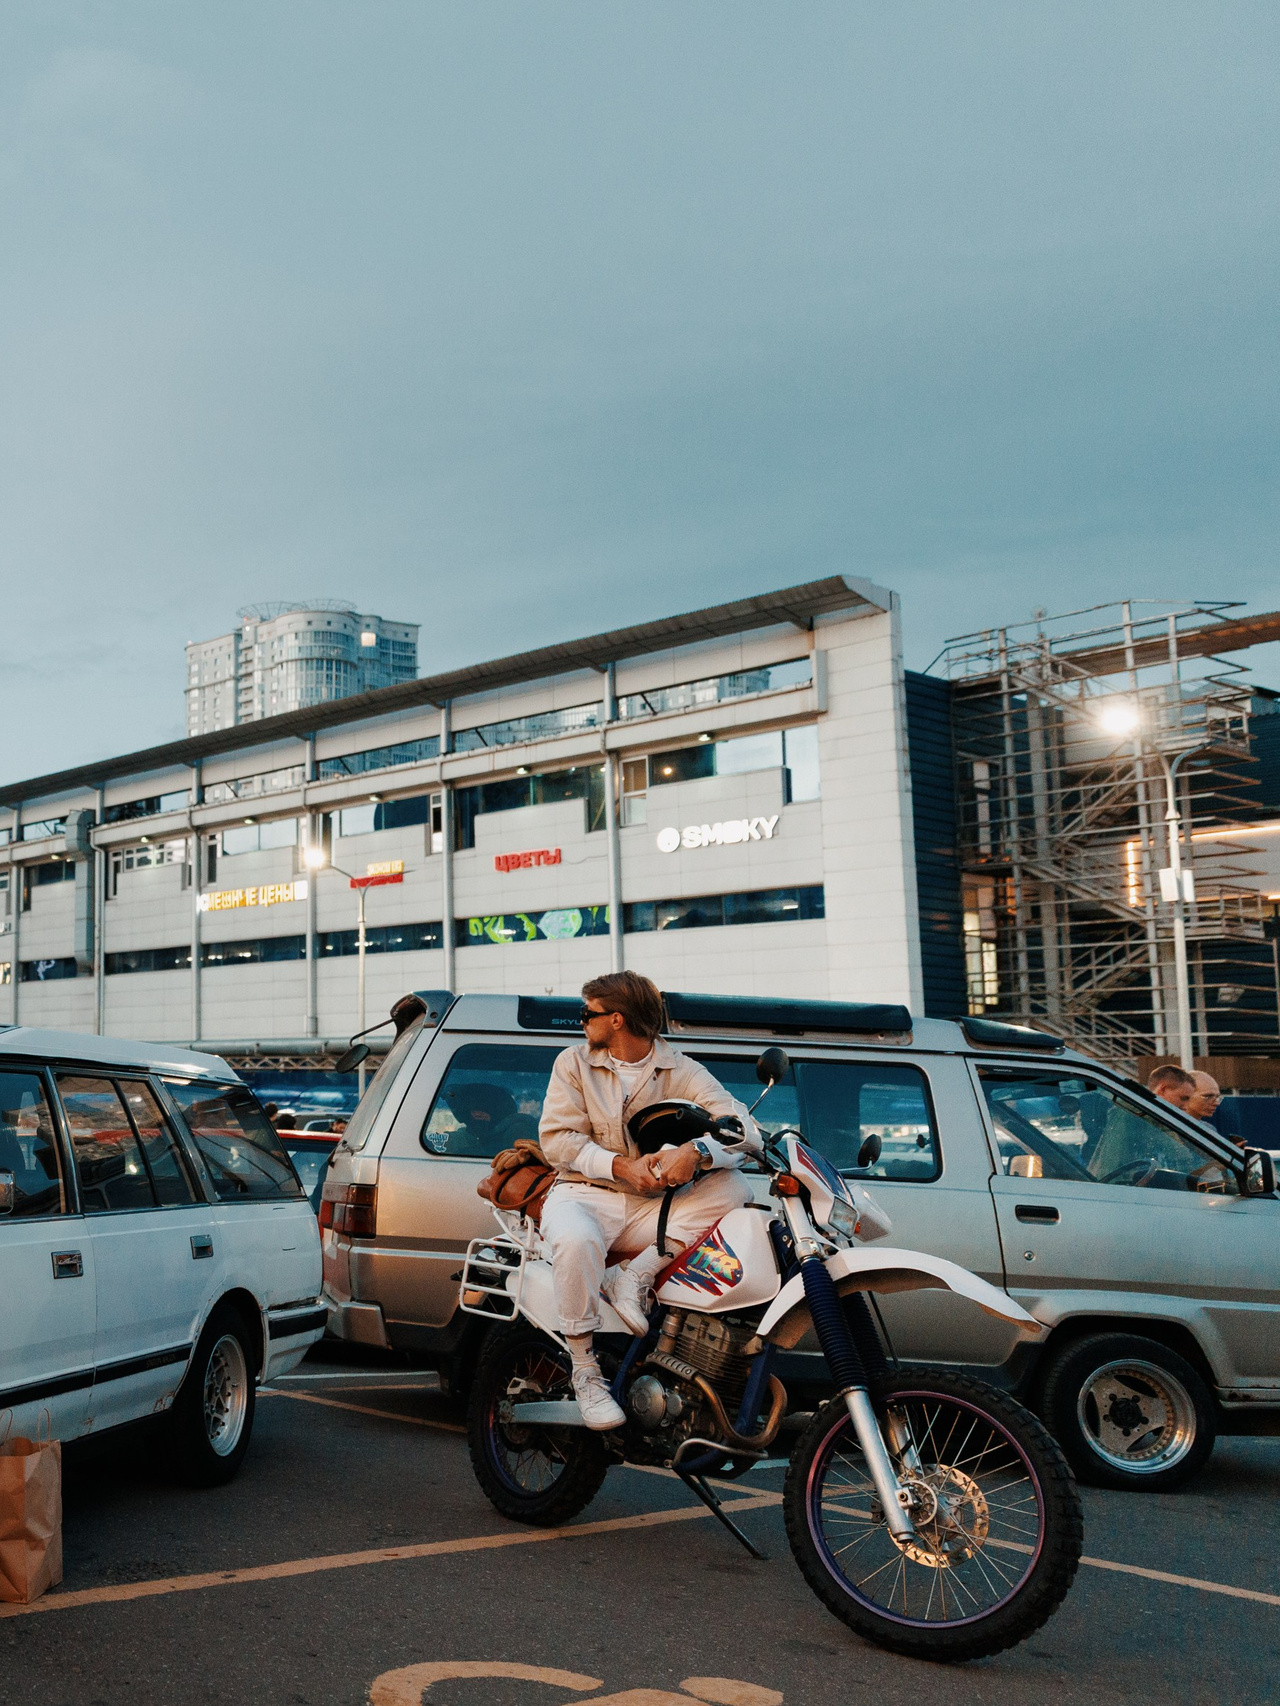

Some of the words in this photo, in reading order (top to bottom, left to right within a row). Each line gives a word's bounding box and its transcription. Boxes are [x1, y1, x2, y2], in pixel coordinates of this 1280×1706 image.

[493, 848, 562, 874] ЦВЕТЫ
[258, 881, 296, 908] ЦЕНЫ
[551, 1018, 582, 1026] SKYL
